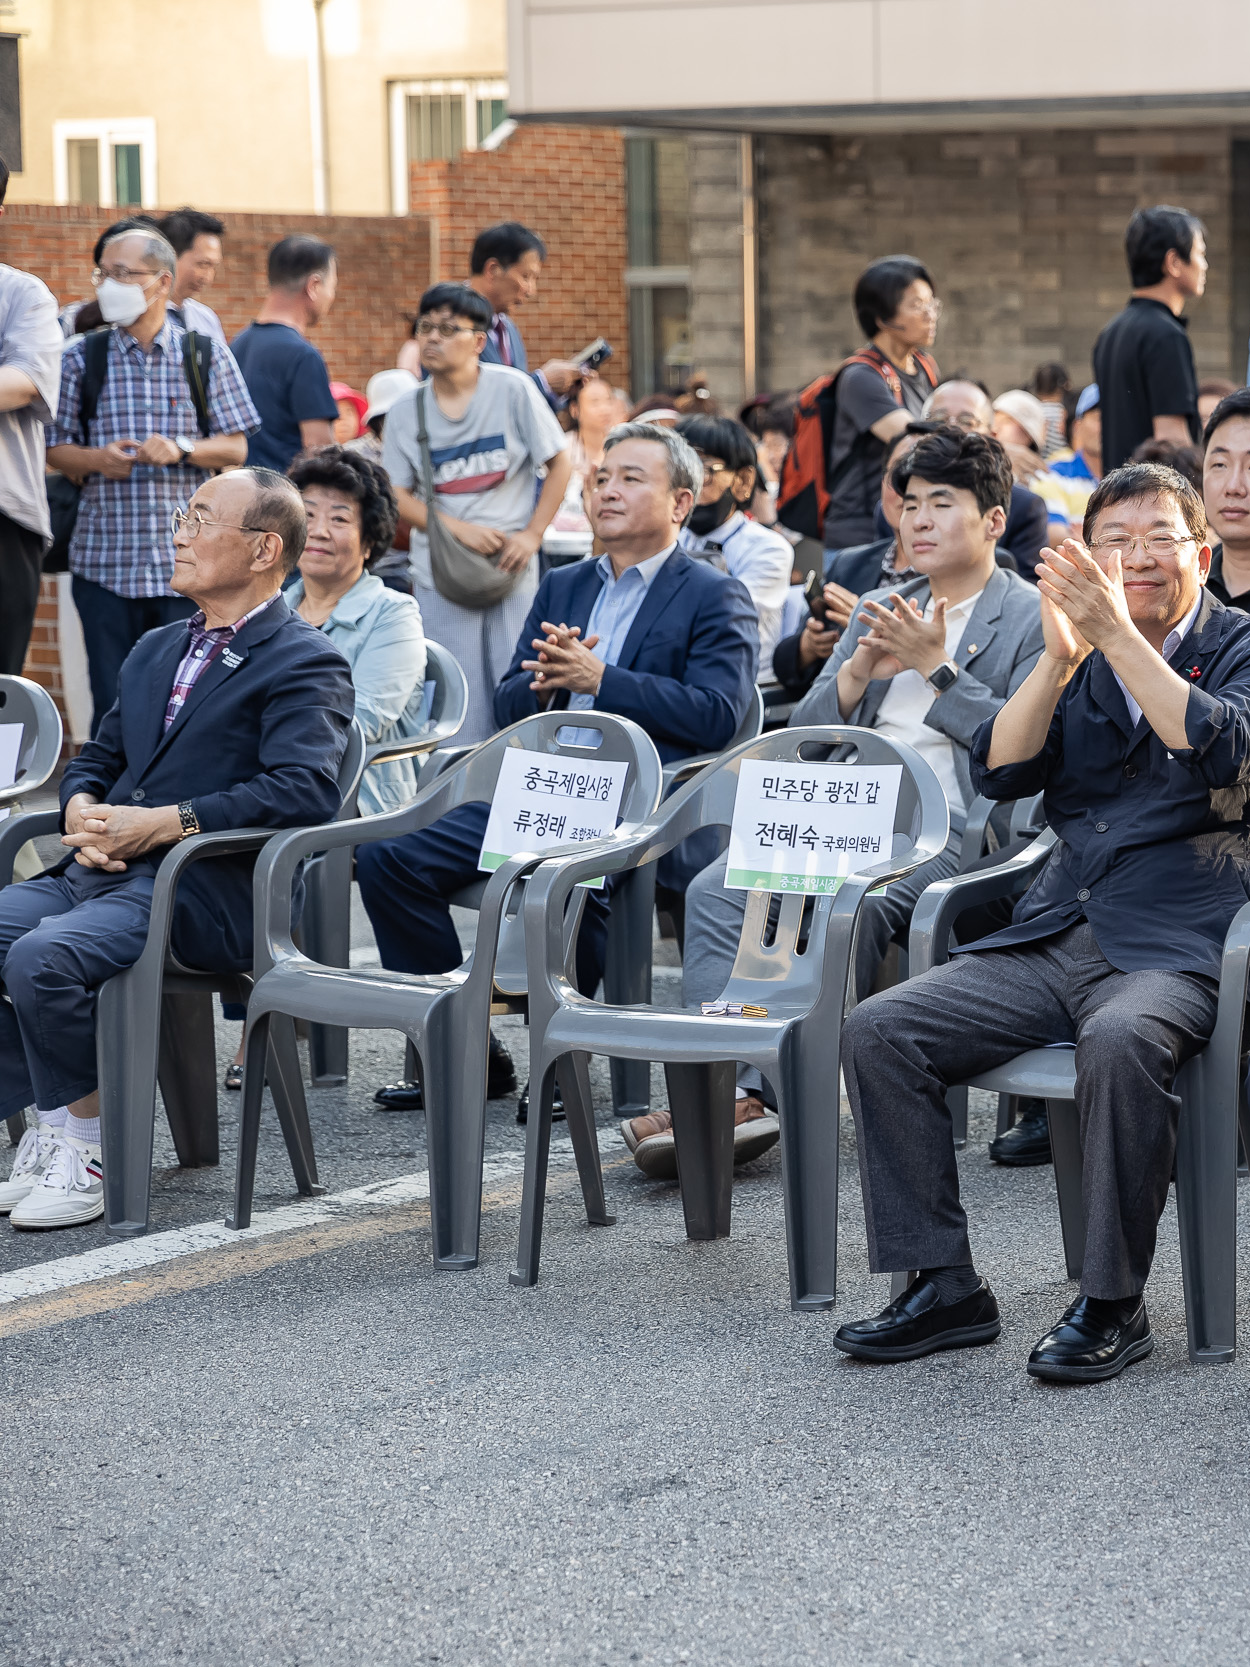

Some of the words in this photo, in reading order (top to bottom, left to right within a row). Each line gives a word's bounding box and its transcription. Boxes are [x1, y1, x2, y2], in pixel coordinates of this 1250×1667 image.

[524, 766, 613, 801] 중곡제일시장
[762, 777, 819, 802] 민주당
[824, 781, 859, 804] 광진
[865, 781, 881, 804] 갑
[513, 809, 567, 839] 류정래
[755, 822, 820, 851] 전혜숙
[822, 835, 881, 853] 국회의원님
[779, 875, 838, 892] 중곡제일시장
